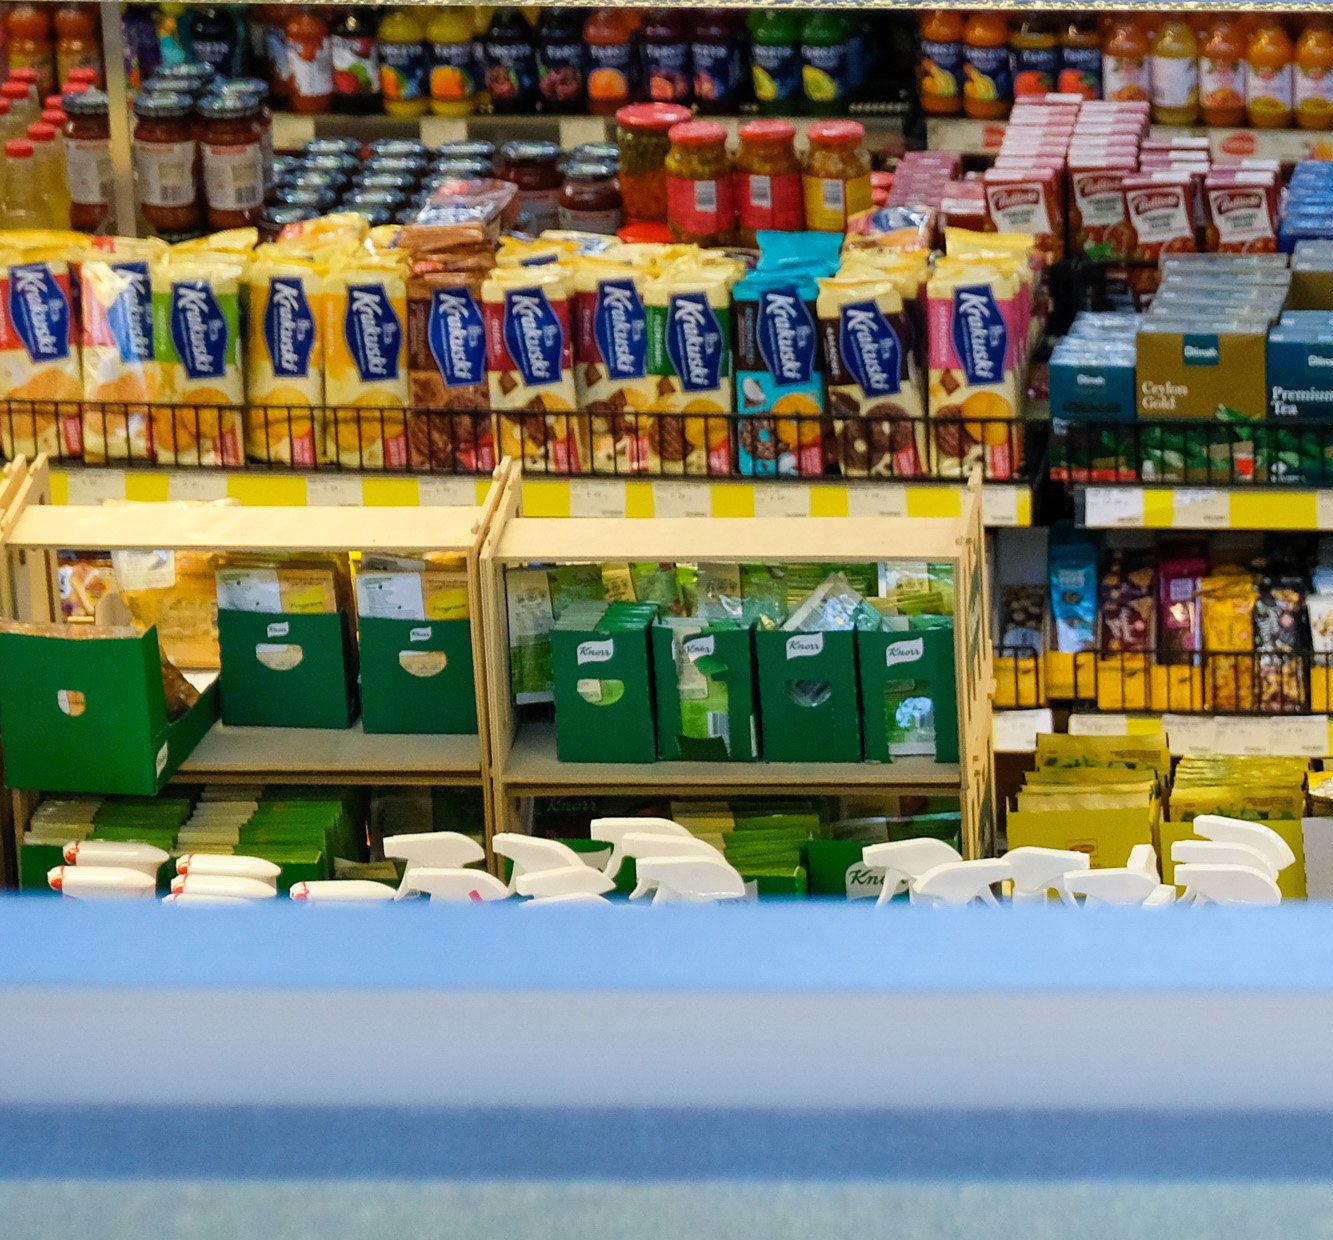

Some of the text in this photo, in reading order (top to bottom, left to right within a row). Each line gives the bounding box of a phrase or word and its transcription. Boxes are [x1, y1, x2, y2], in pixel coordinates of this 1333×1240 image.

[675, 300, 711, 387] Krakuski
[766, 293, 803, 382] Krakuski
[848, 308, 889, 393] Krakuski
[956, 288, 993, 381] Krakuski
